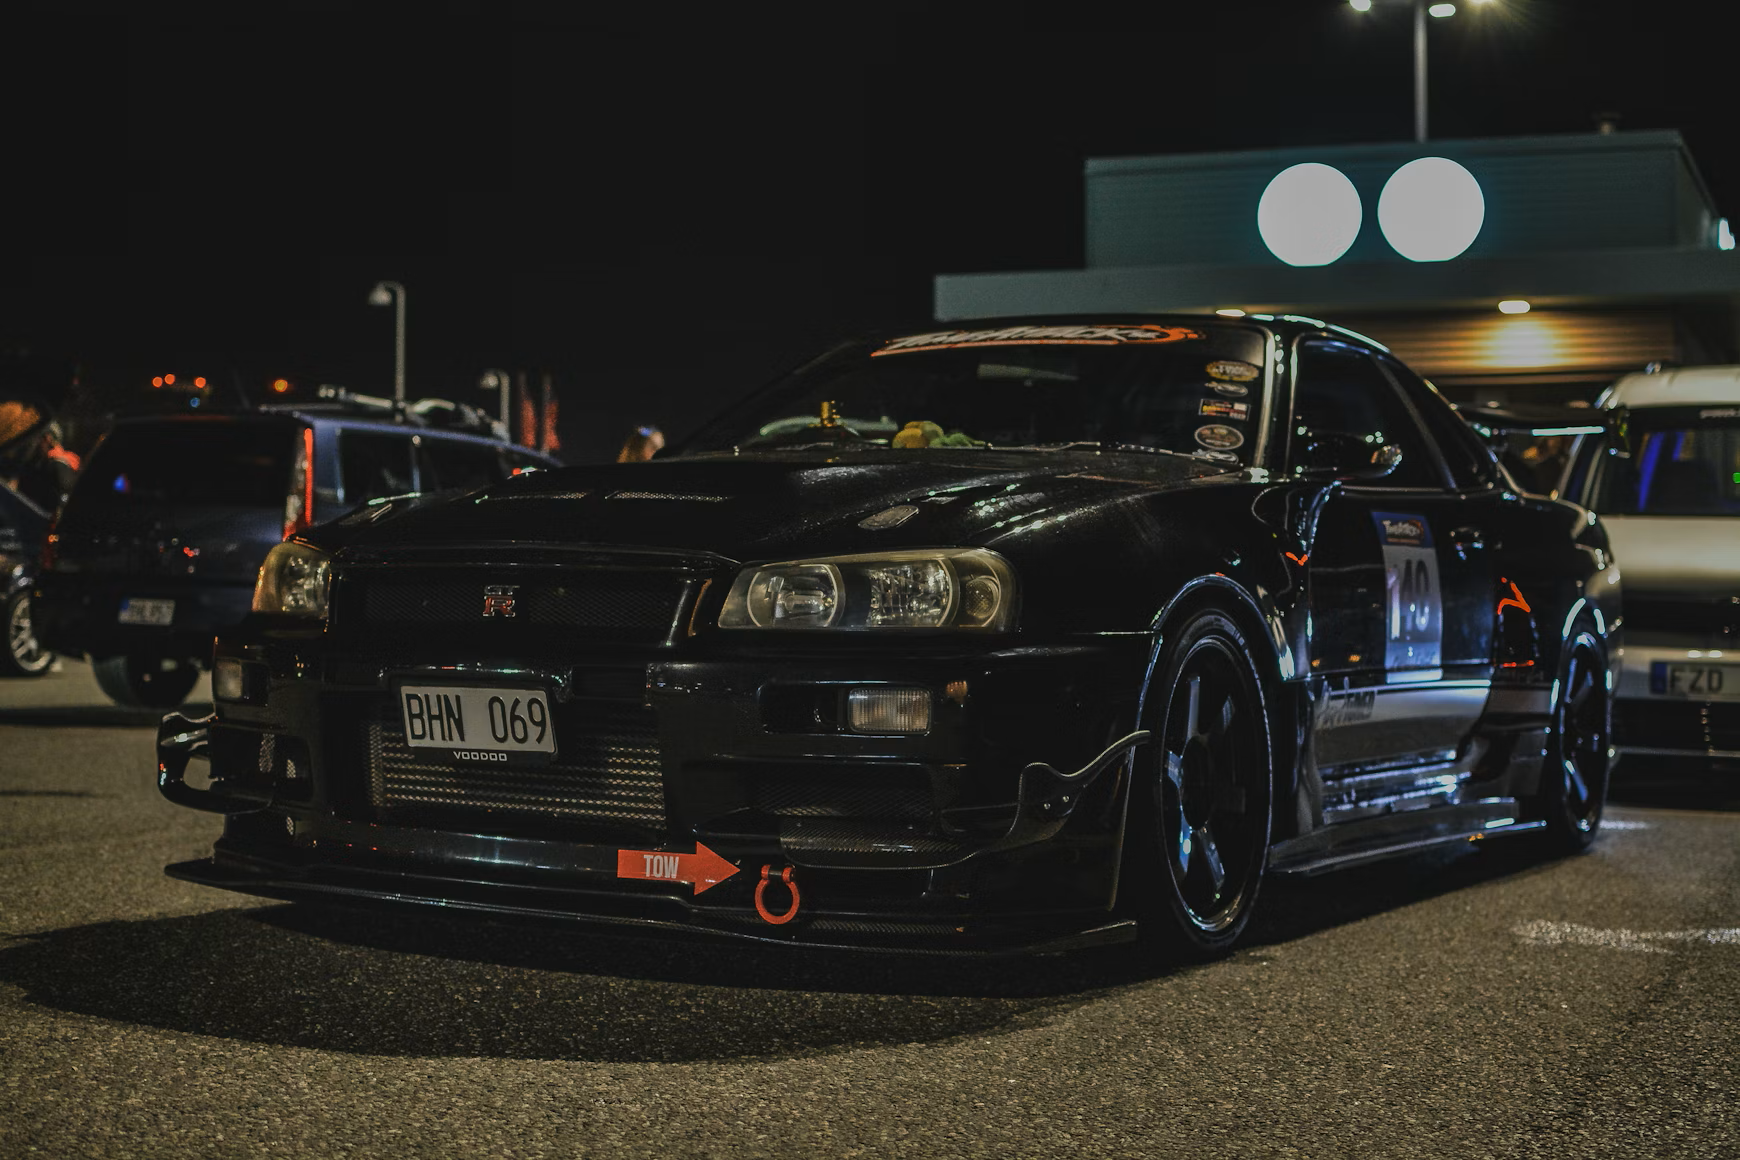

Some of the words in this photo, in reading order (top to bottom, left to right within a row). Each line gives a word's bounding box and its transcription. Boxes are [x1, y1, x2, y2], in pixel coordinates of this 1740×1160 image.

[482, 595, 516, 617] R
[405, 693, 466, 742] BHN
[488, 695, 546, 745] 069
[452, 750, 508, 762] VOODOO
[643, 854, 680, 879] TOW
